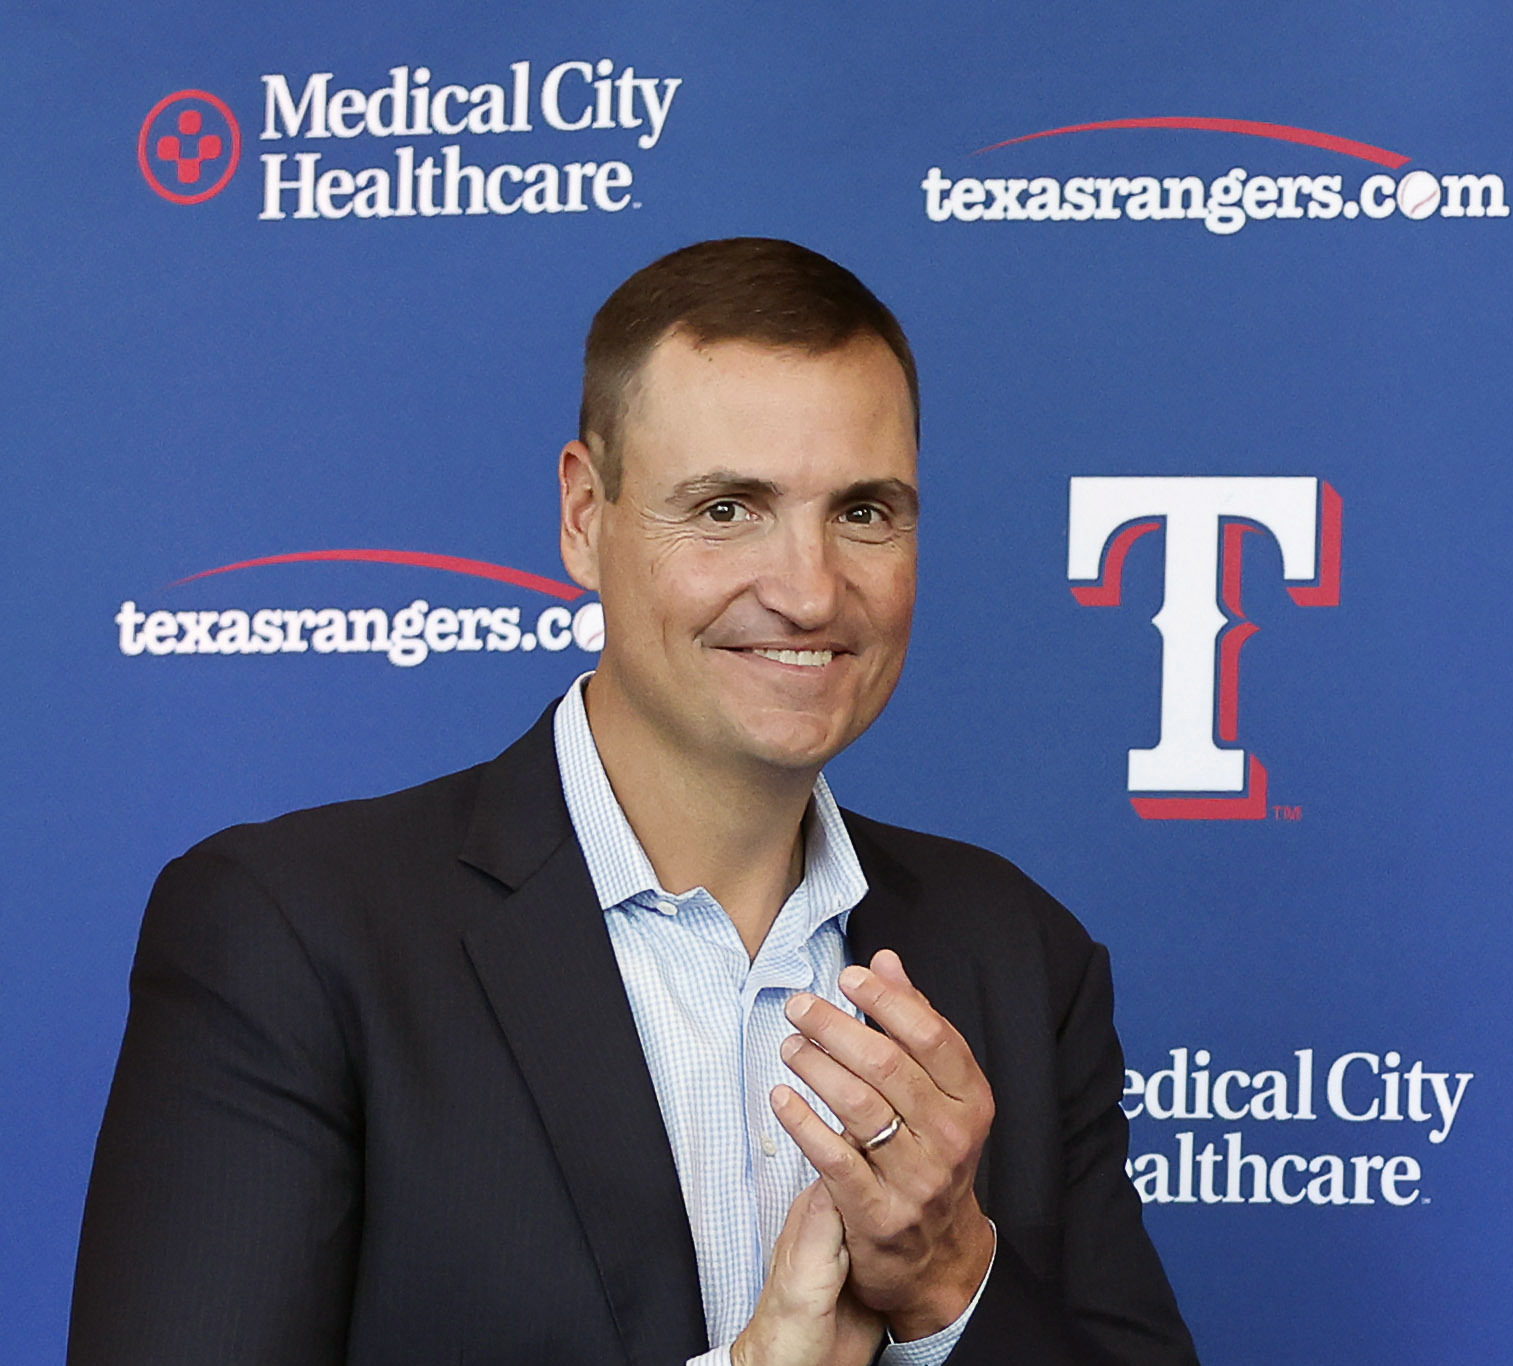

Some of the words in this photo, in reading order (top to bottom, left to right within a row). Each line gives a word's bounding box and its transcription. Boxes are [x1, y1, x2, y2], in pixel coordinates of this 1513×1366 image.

[260, 60, 533, 140] Medical
[541, 58, 683, 150] City
[258, 144, 633, 220] Healthcare
[921, 167, 1510, 235] texasrangers.com
[1067, 476, 1344, 821] T
[1327, 1051, 1474, 1144] City
[1124, 1131, 1421, 1206] althcare
